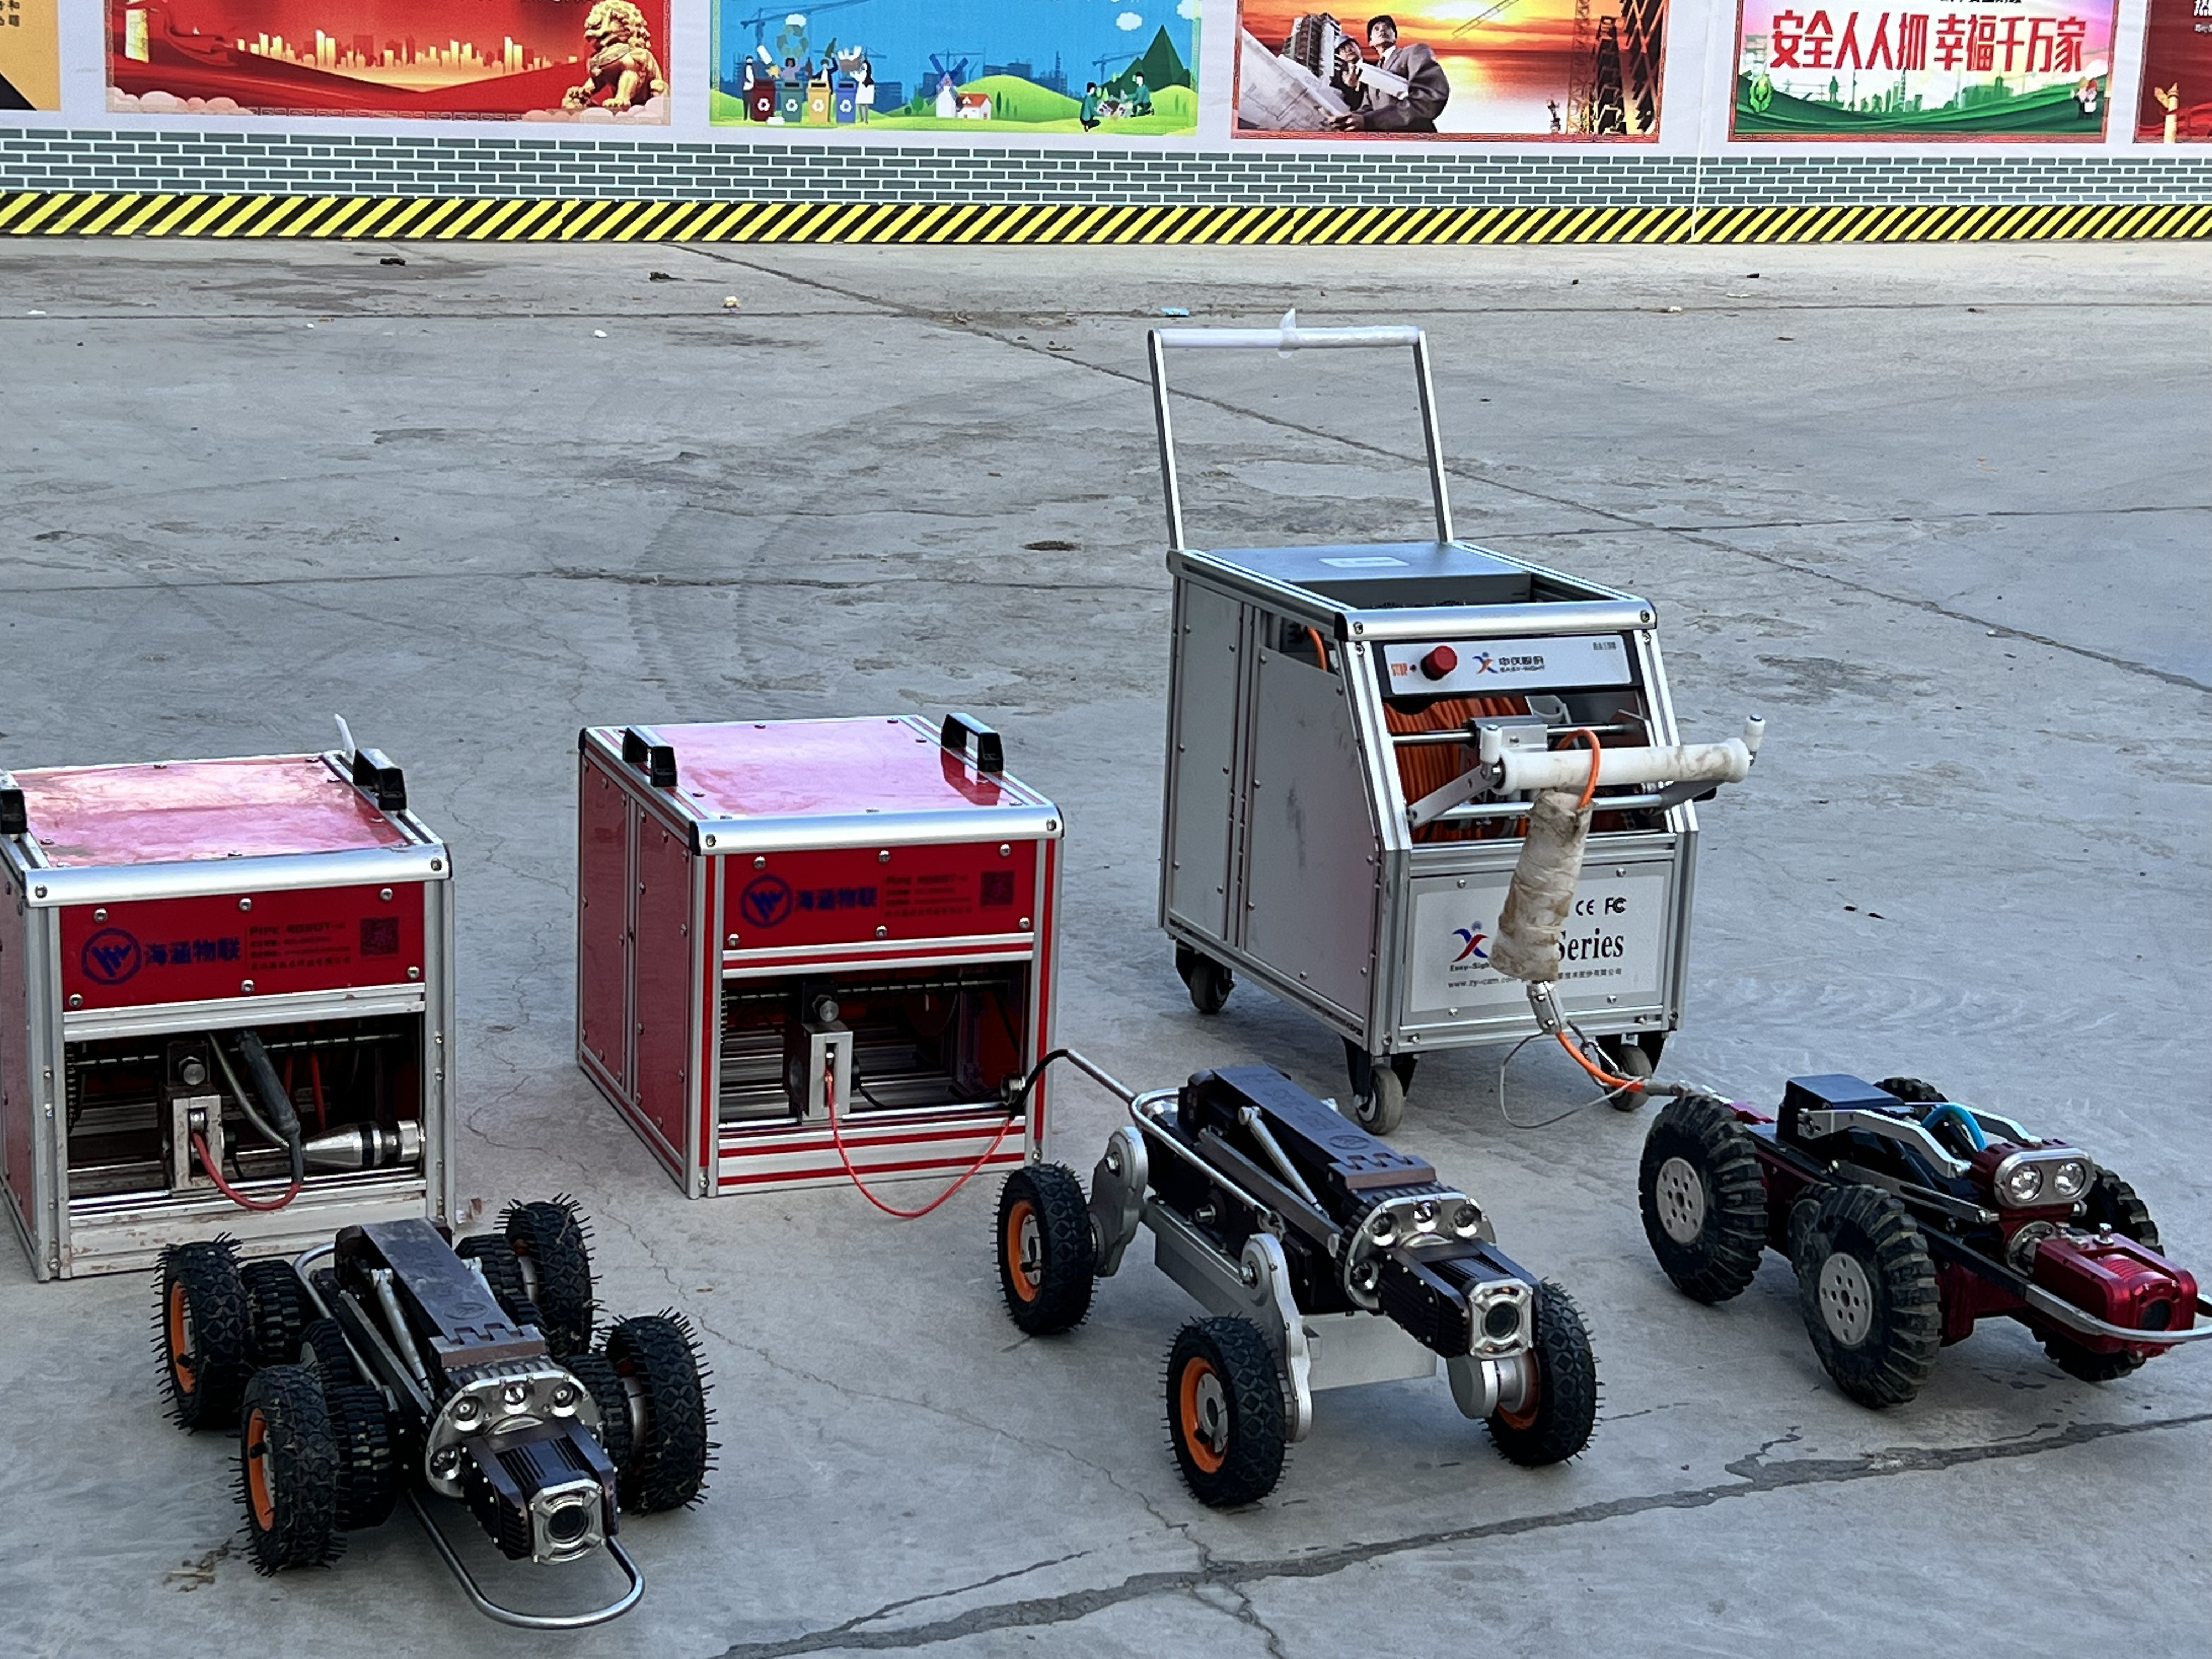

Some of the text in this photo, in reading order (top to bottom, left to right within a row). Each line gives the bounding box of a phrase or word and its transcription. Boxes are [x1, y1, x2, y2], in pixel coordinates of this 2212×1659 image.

[1770, 10, 2086, 72] 安全人人抓 幸福千万家
[144, 936, 240, 967] 海涵物联
